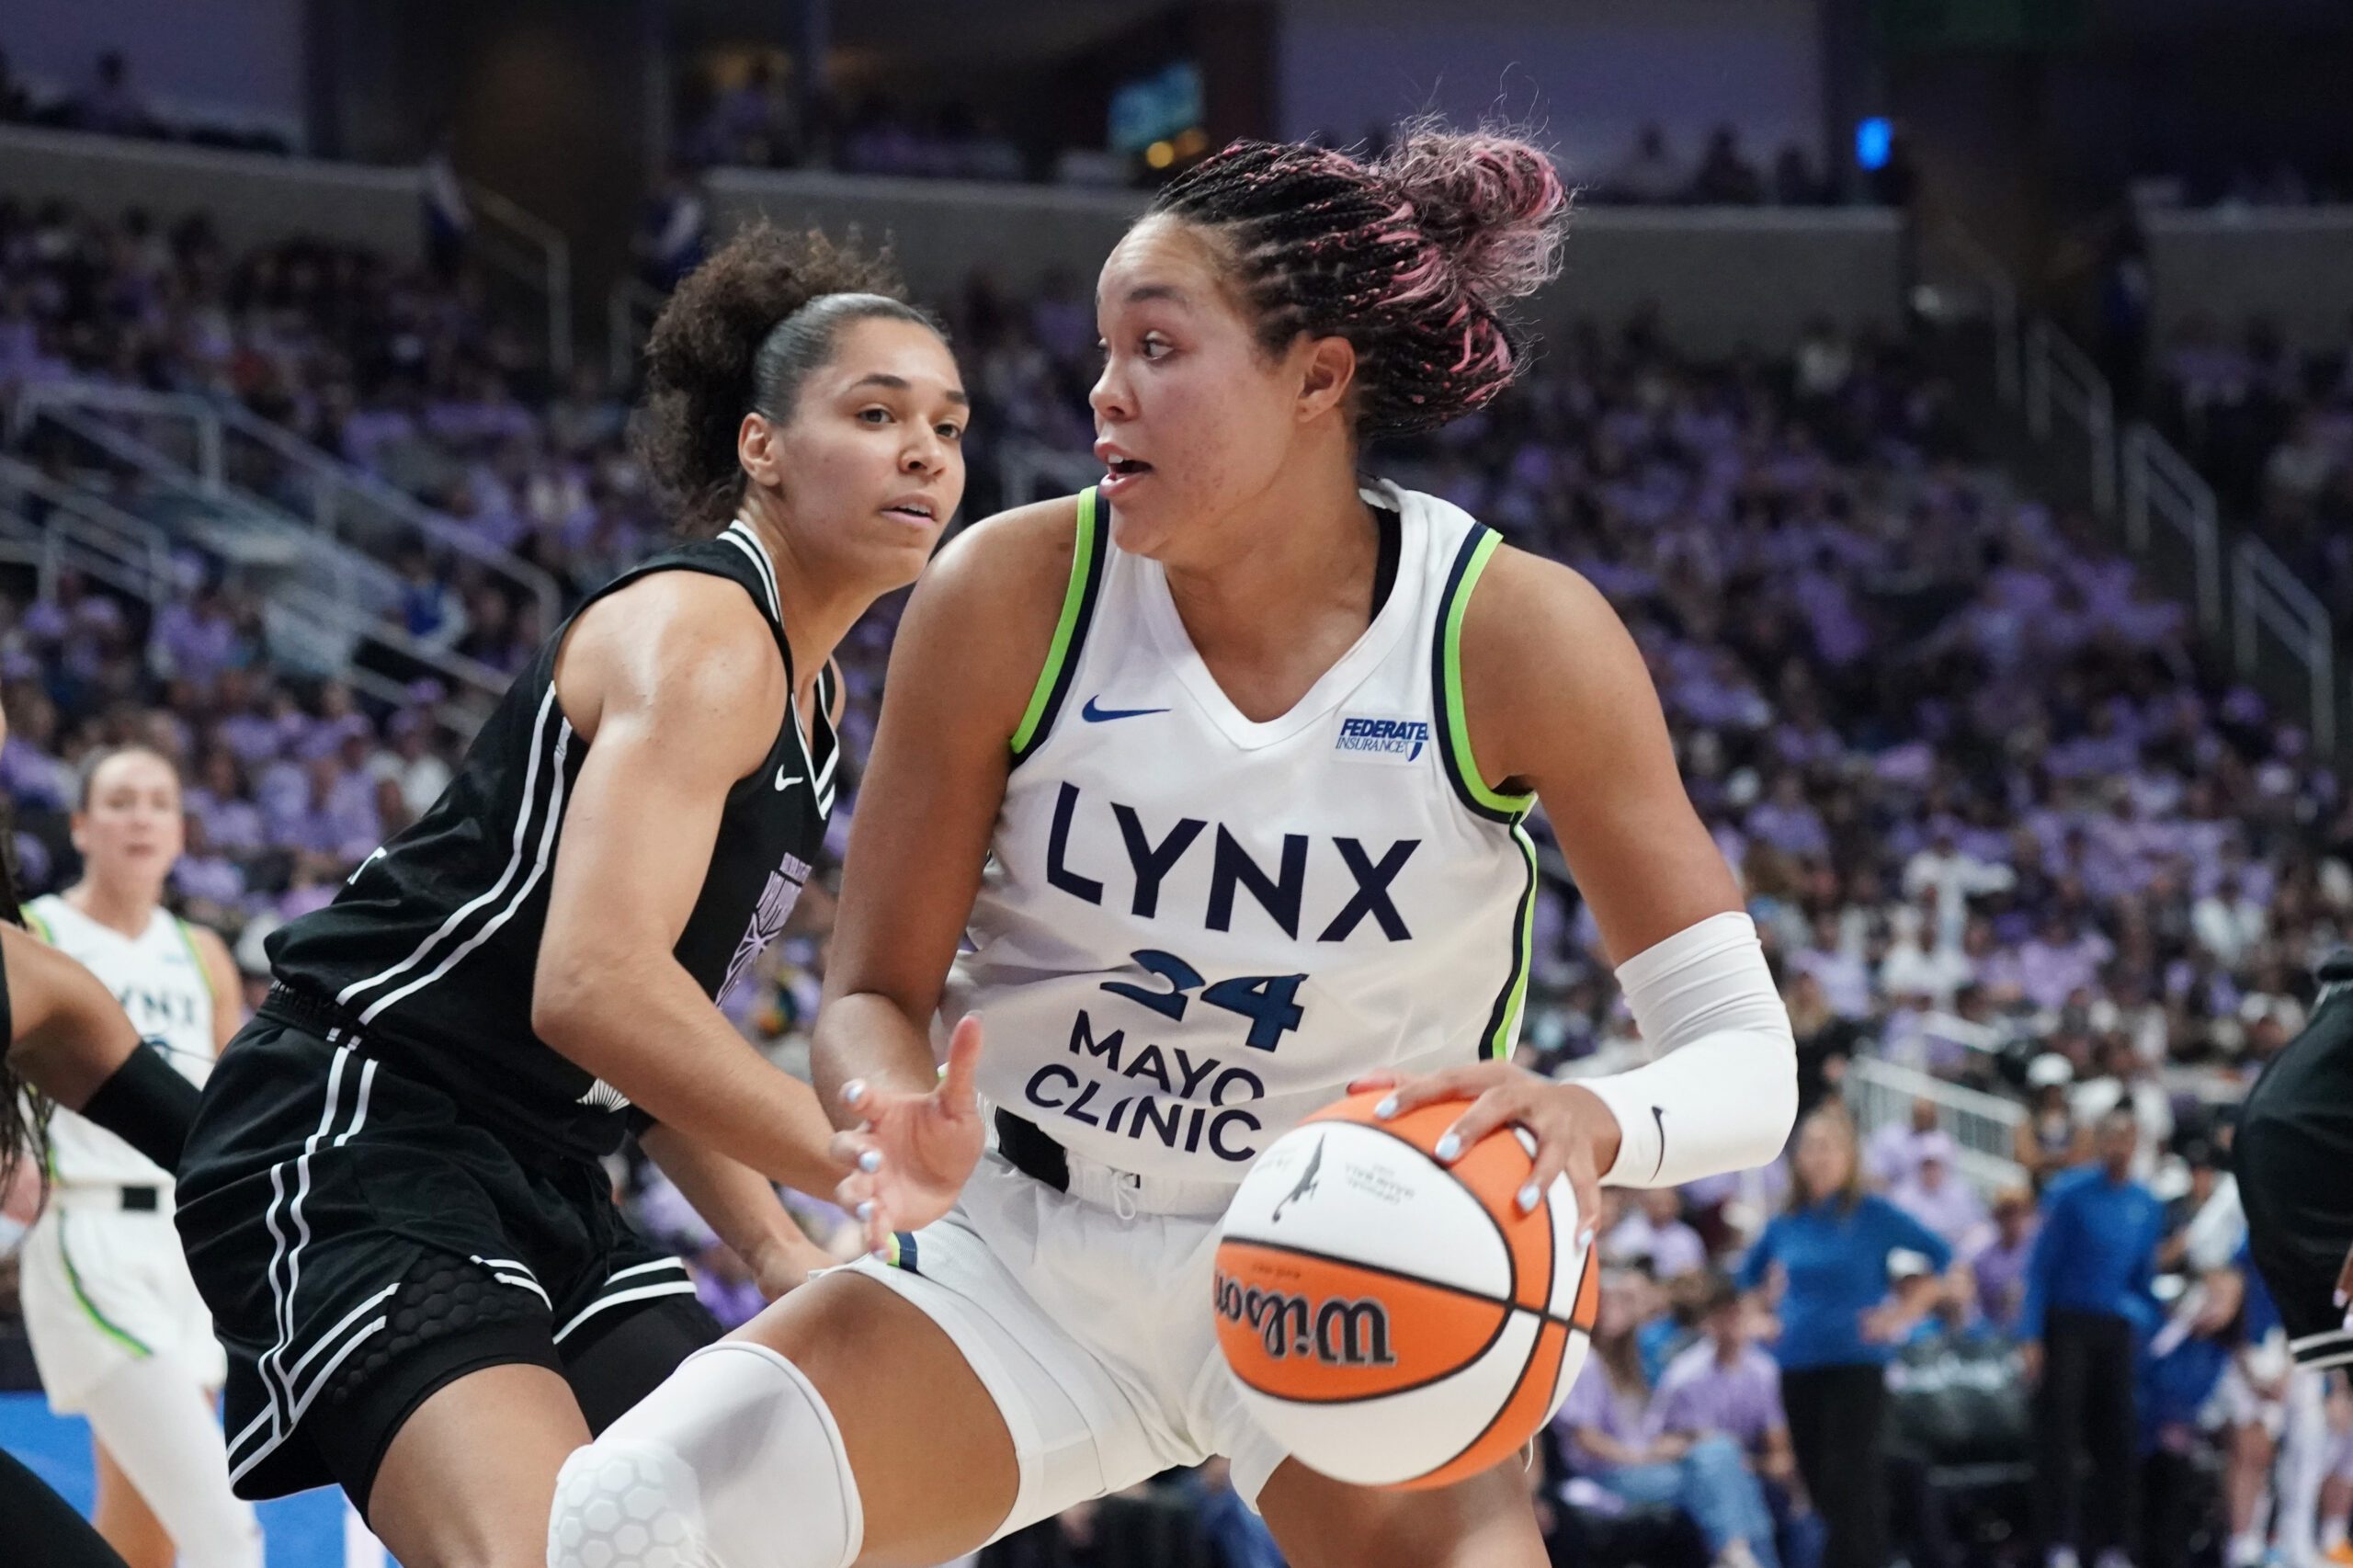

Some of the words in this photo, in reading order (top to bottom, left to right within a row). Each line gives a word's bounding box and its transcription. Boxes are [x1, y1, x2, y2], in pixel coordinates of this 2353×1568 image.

[1336, 736, 1405, 754] INSURANCE
[1340, 718, 1428, 740] FEDERATE
[1047, 781, 1422, 942] LYNX
[1099, 949, 1310, 1052] 24
[1069, 1009, 1265, 1107] MAYO
[1025, 1063, 1262, 1162] CLINIC
[1214, 1272, 1397, 1367] Wilson
